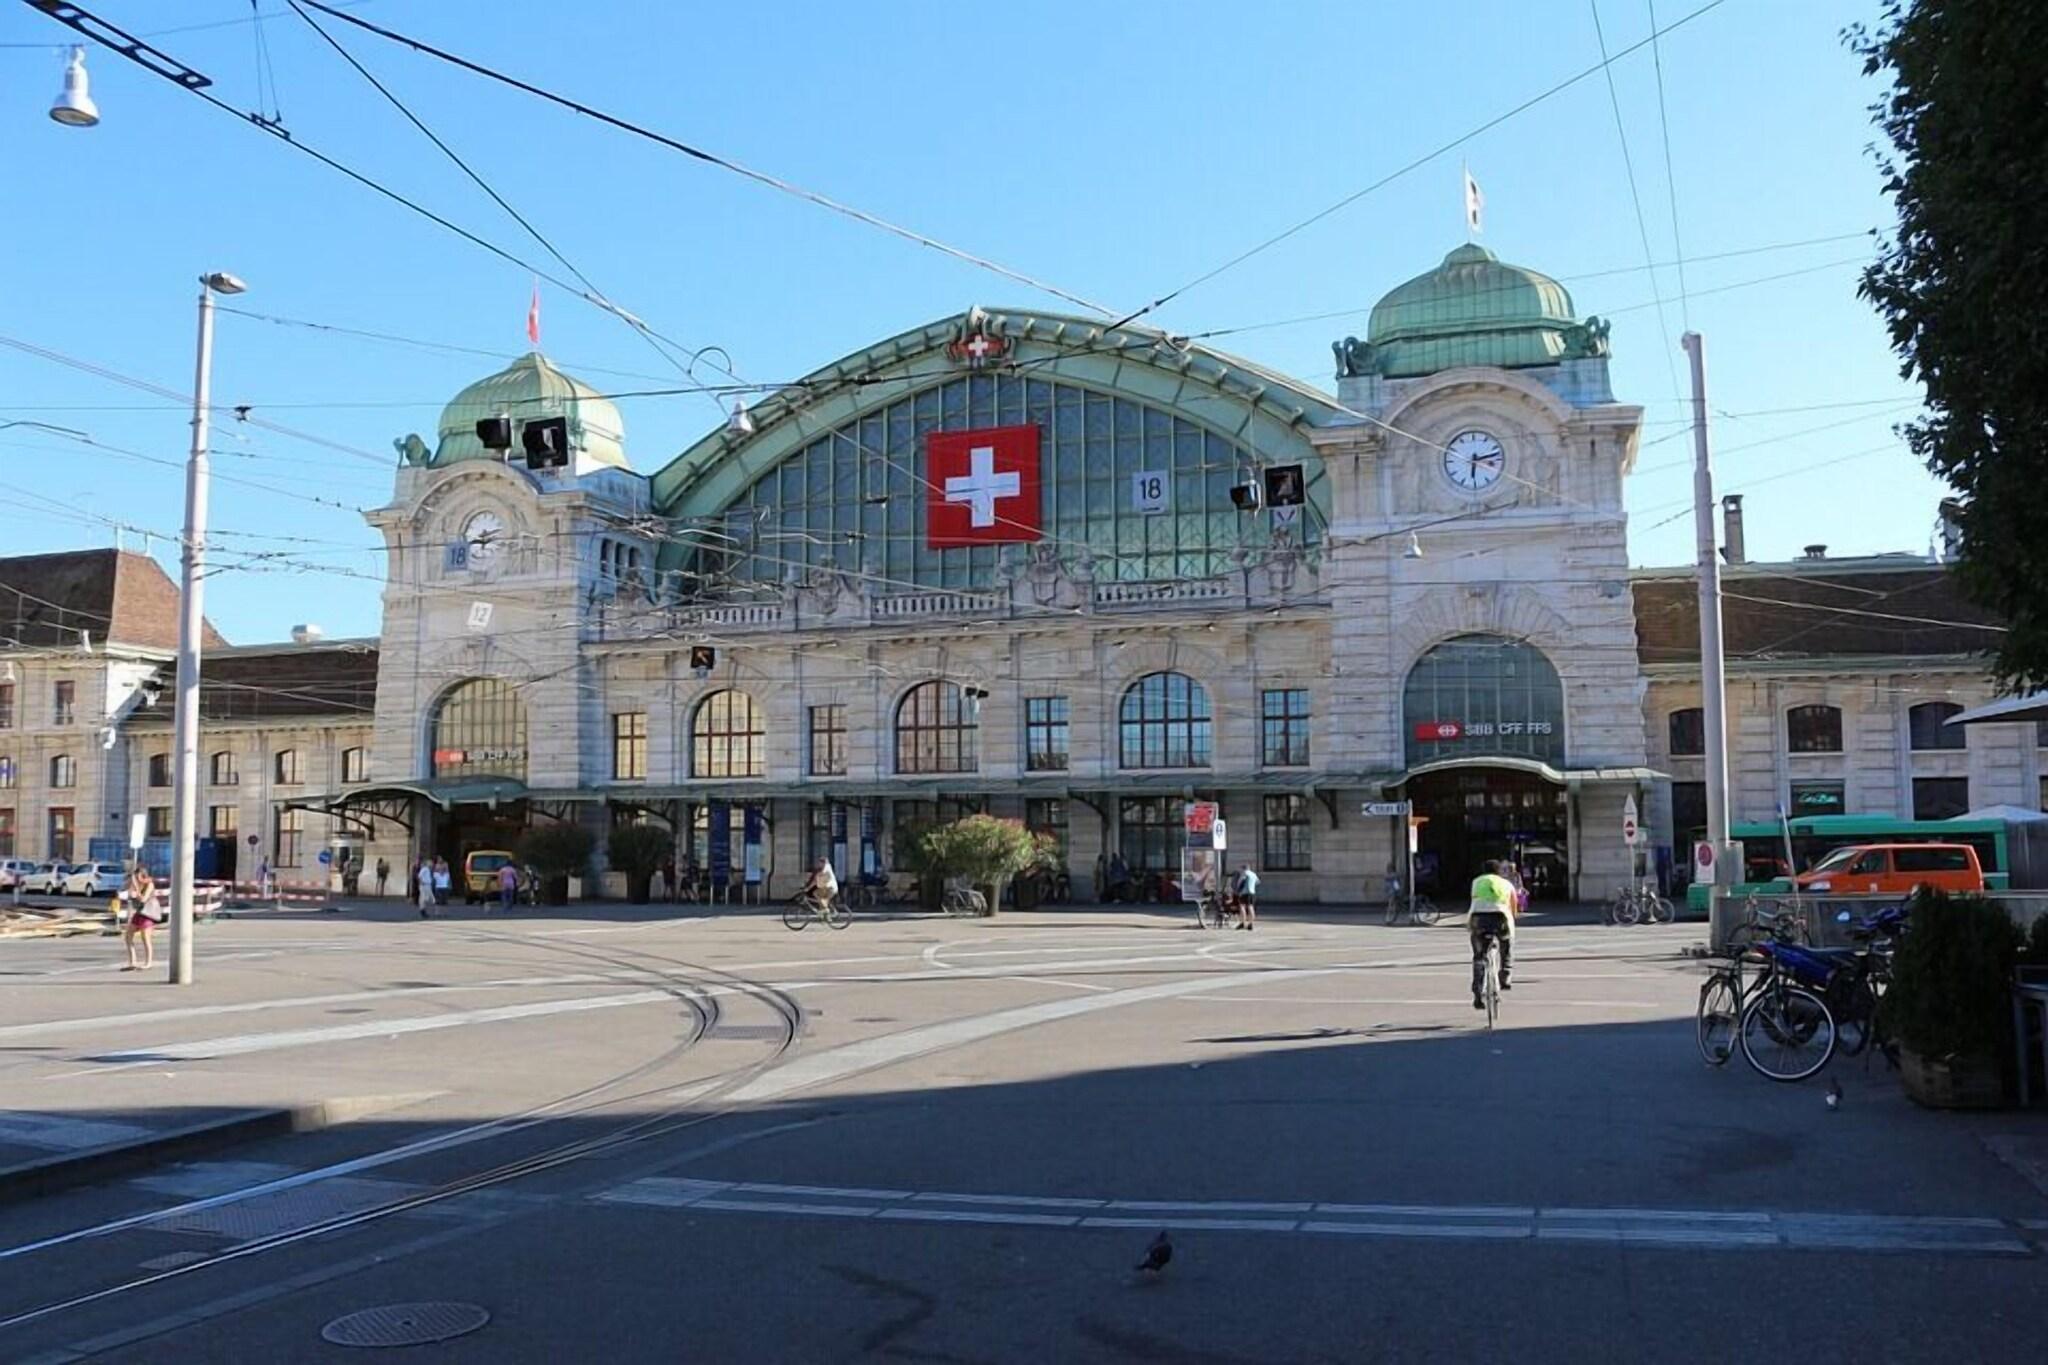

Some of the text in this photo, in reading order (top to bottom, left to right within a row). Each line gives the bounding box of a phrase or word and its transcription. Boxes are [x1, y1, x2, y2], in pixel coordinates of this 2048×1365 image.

[1140, 477, 1161, 500] 18
[1465, 722, 1552, 736] SBB CFF FFS
